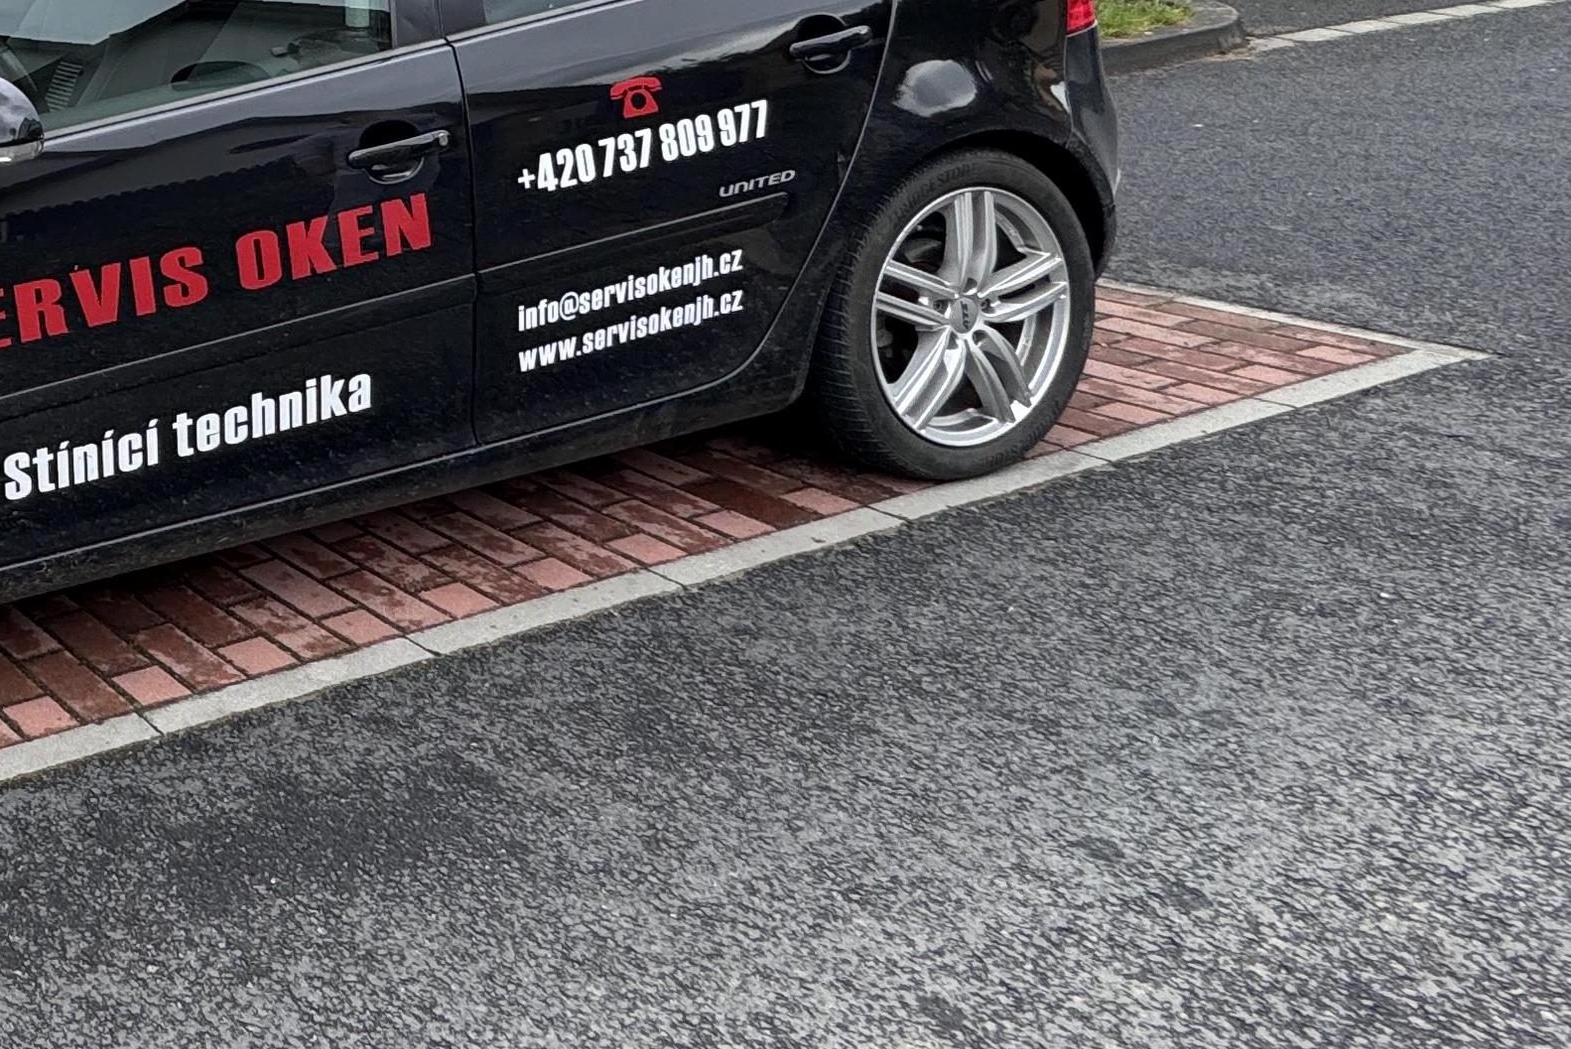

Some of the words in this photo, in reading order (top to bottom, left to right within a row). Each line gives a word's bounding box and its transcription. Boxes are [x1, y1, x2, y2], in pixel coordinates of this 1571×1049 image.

[517, 143, 596, 192] +420
[598, 127, 652, 178] 737
[659, 114, 714, 162] 809
[717, 99, 768, 147] 977
[719, 169, 796, 198] UNITED
[235, 192, 431, 290] OKEN
[518, 249, 743, 331] info@servisokenjh.cz
[518, 289, 743, 373] www.servisokenjh.cz
[4, 420, 159, 501] Stínící
[173, 373, 372, 459] technika
